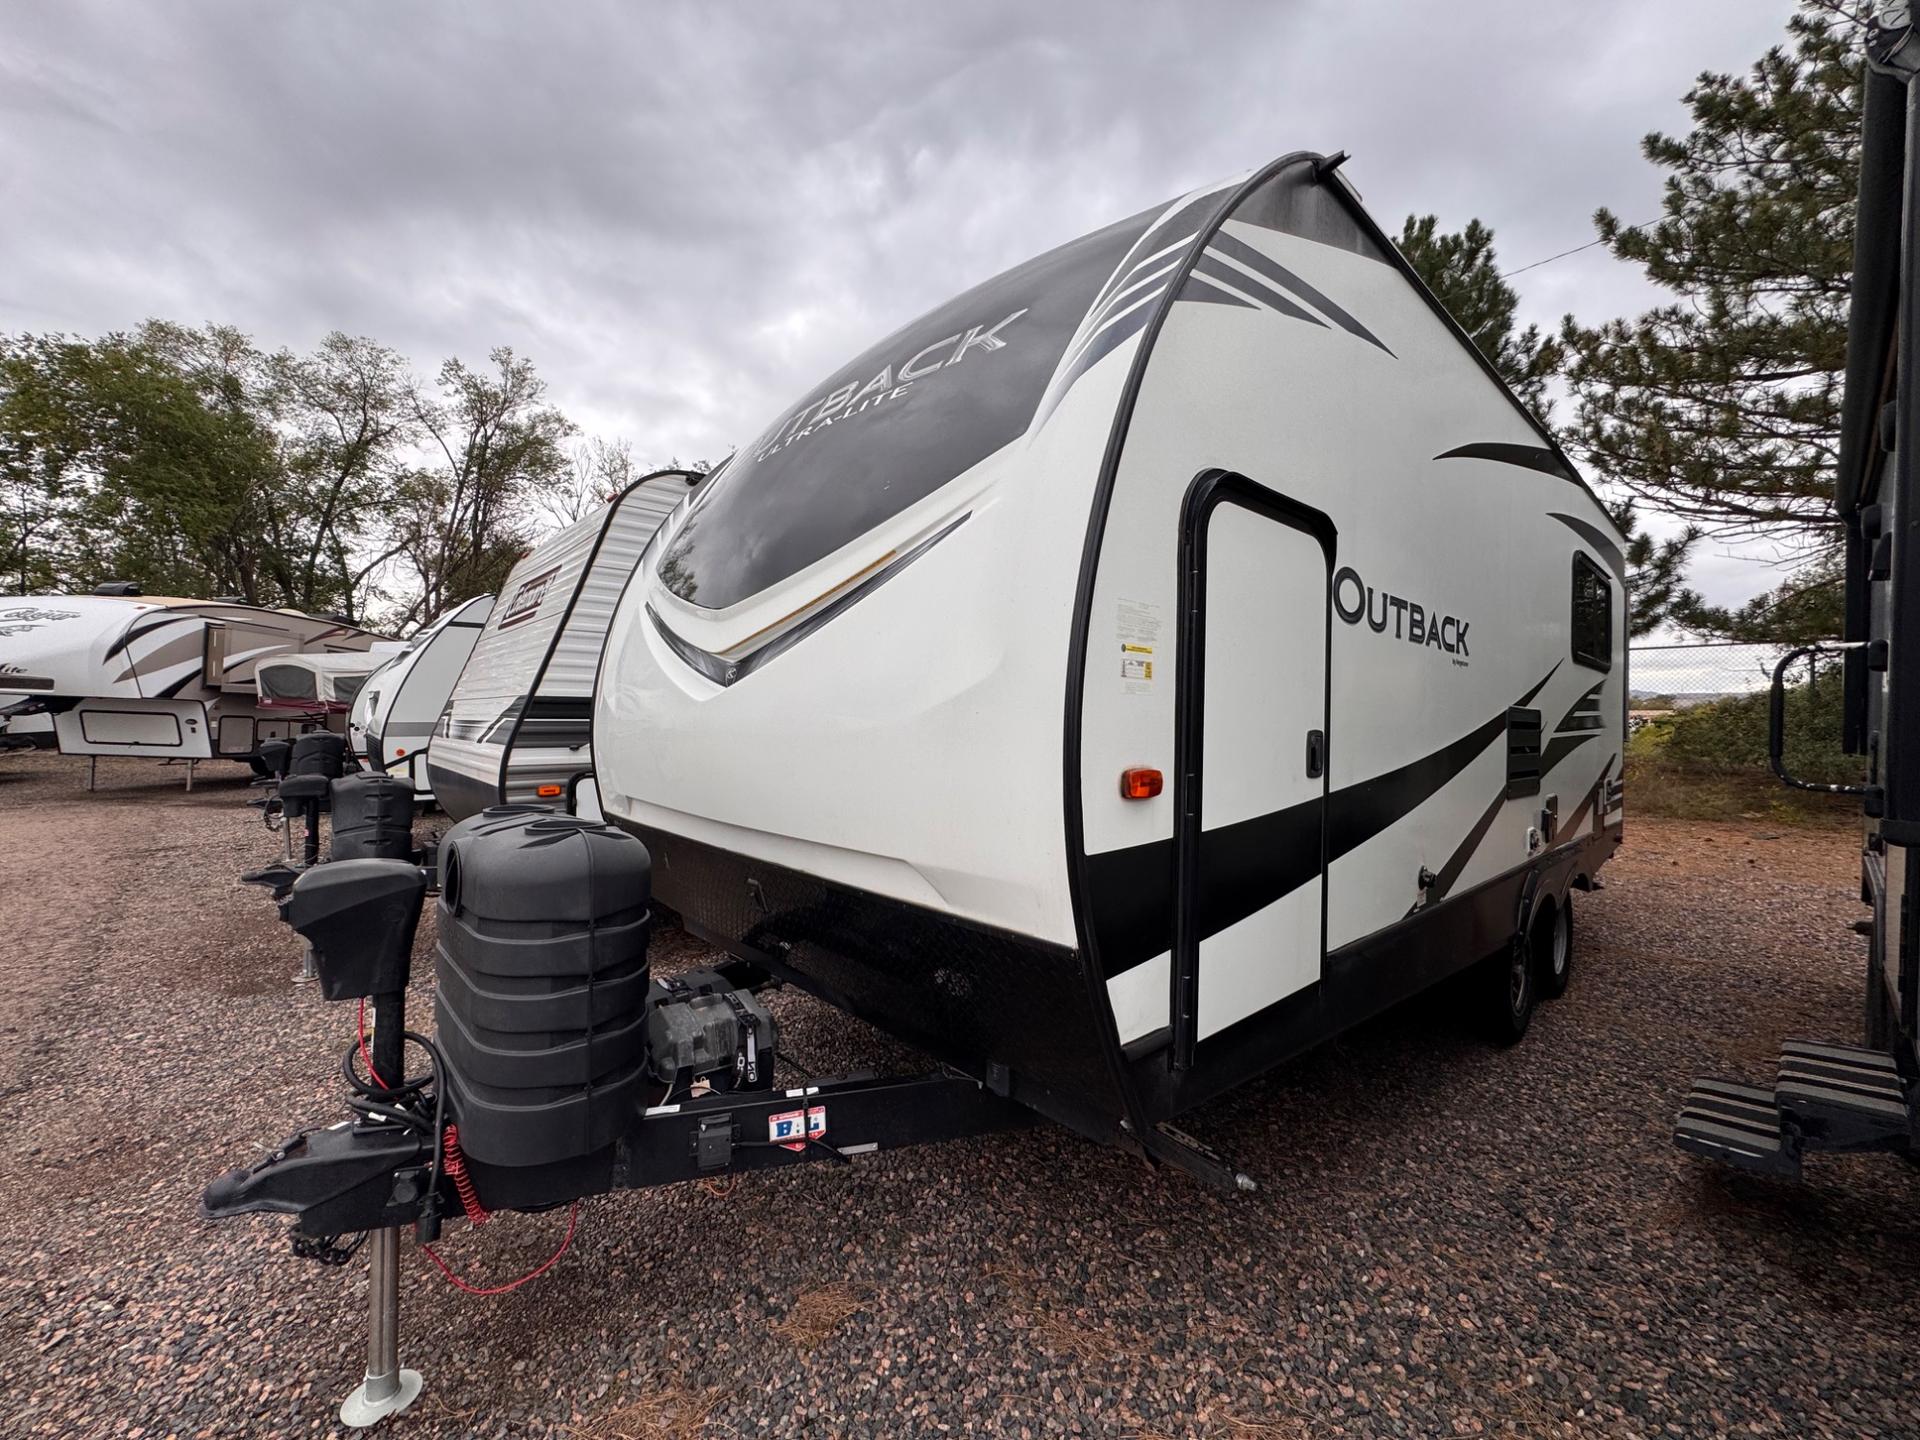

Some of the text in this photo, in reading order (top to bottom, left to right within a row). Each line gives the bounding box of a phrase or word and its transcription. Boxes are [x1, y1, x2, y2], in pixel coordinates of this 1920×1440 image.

[750, 308, 1029, 457] UTBACK
[757, 382, 913, 462] ULTRA-LITE
[1333, 566, 1470, 657] OUTBACK
